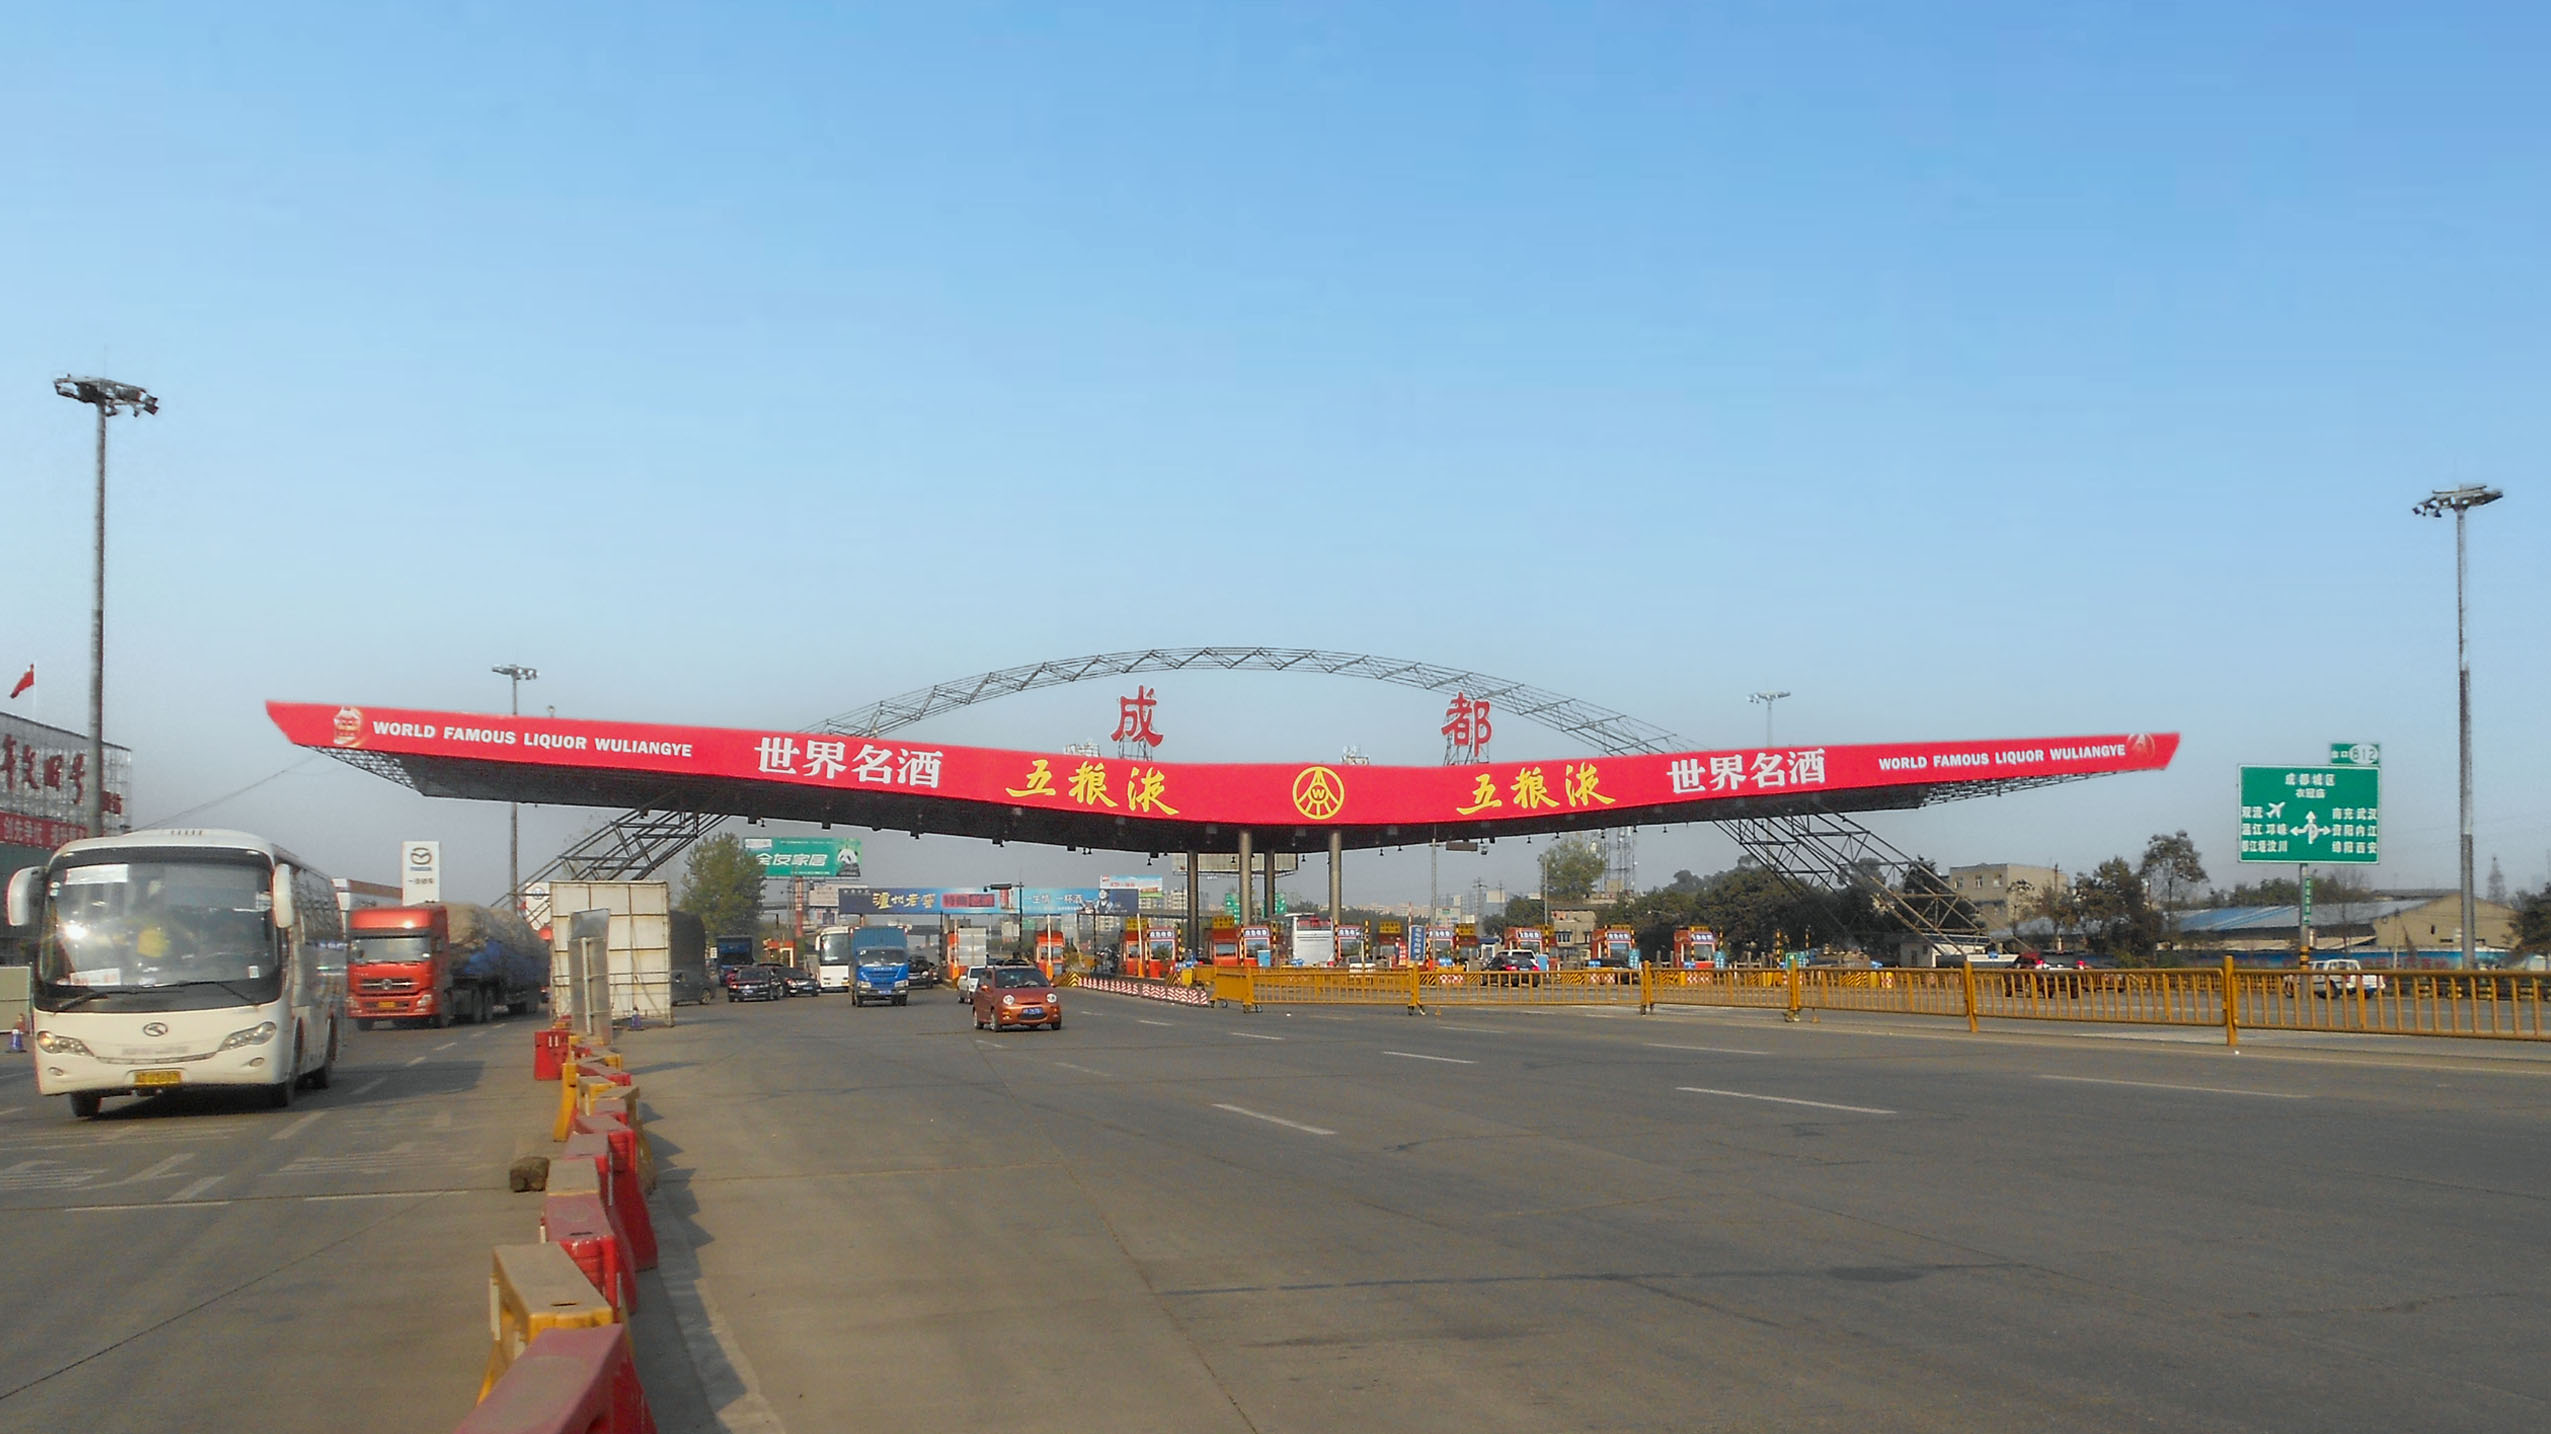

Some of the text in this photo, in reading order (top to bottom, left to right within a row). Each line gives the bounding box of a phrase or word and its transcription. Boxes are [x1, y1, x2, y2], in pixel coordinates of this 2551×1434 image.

[373, 720, 693, 758] WORLD FAMOUS LIQUOR WULIANGYE
[1111, 685, 1492, 757] 成 都
[754, 736, 943, 788] 世界名酒
[1666, 747, 1827, 794] 世界名酒
[1878, 743, 2126, 771] WORLD FAMOUS LIQUOR WULIANGYE
[2285, 773, 2336, 786] 成都城区
[1006, 759, 1180, 816] 五粮液
[1457, 761, 1616, 816] 五粮液
